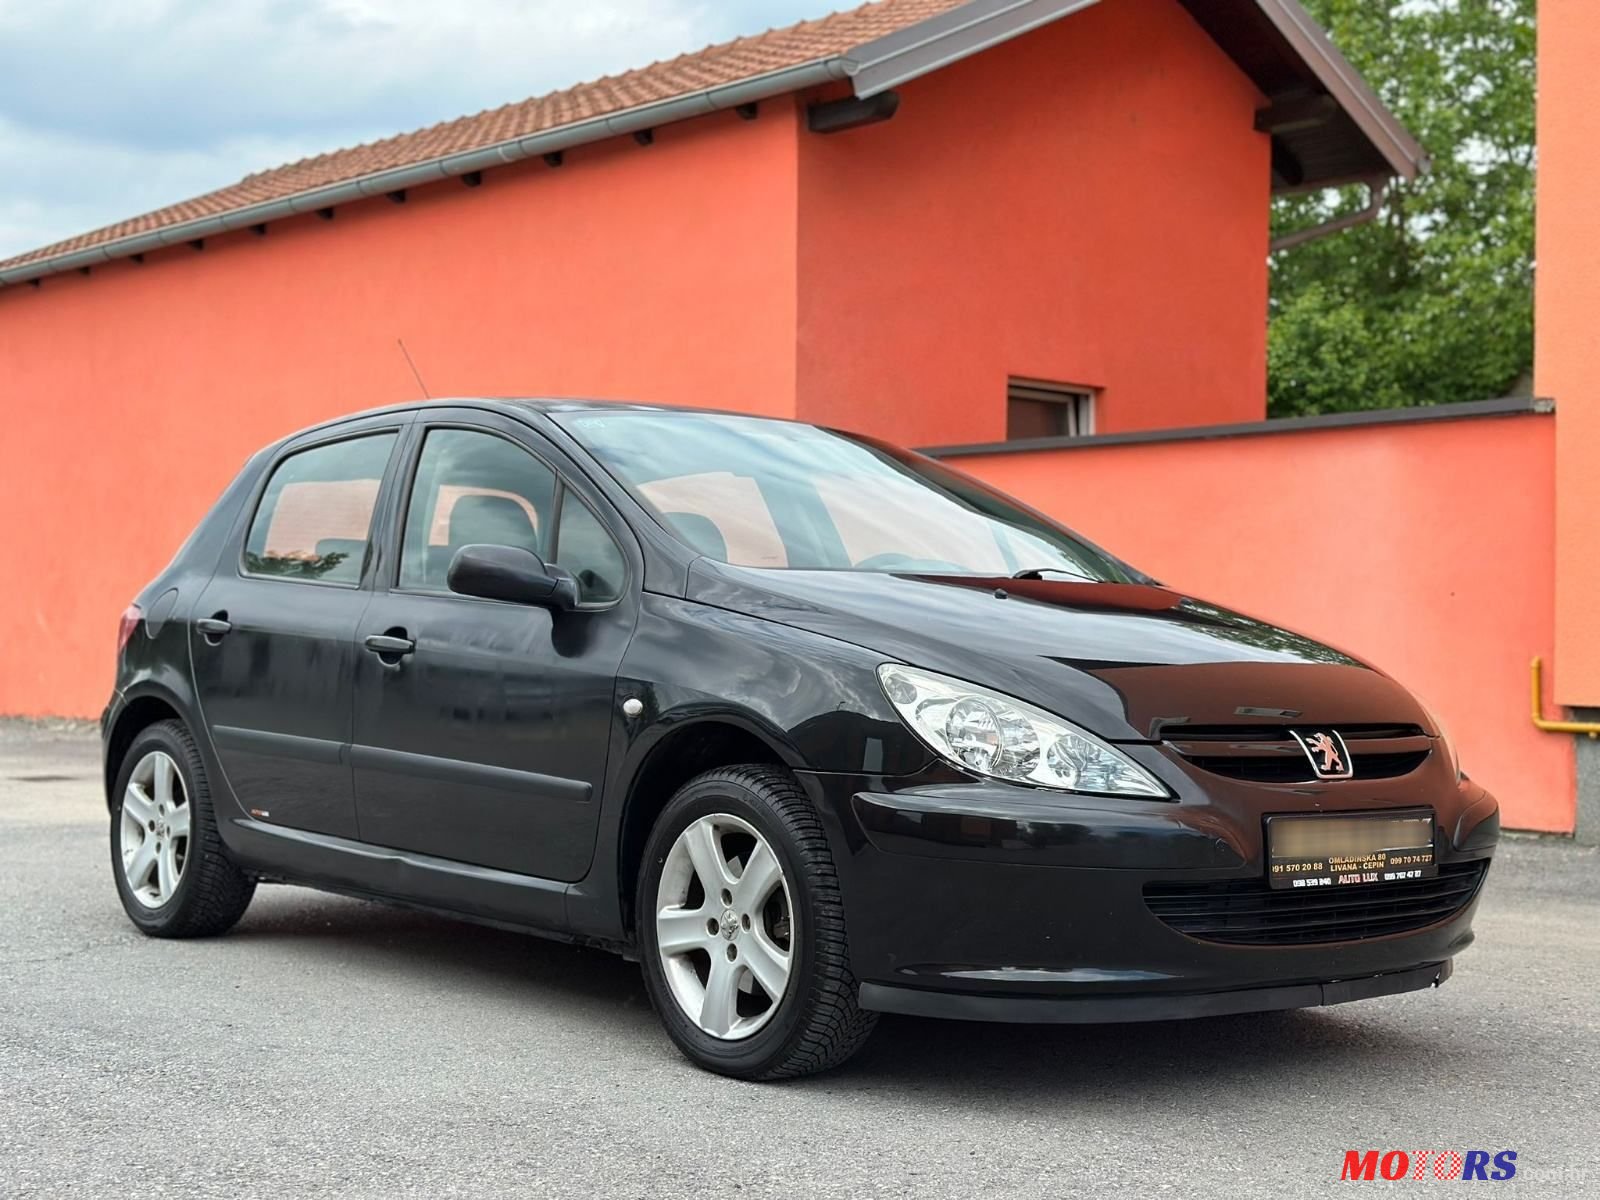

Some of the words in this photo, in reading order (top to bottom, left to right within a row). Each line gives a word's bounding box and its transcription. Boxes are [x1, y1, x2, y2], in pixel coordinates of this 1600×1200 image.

[1328, 854, 1376, 864] OMLADINSKA
[1377, 853, 1386, 861] 80
[1286, 863, 1300, 872] 570
[1302, 863, 1312, 871] 20
[1313, 862, 1323, 870] 88
[1330, 862, 1358, 872] LIVANA
[1338, 873, 1361, 884] AUTO
[1362, 872, 1379, 883] LUX
